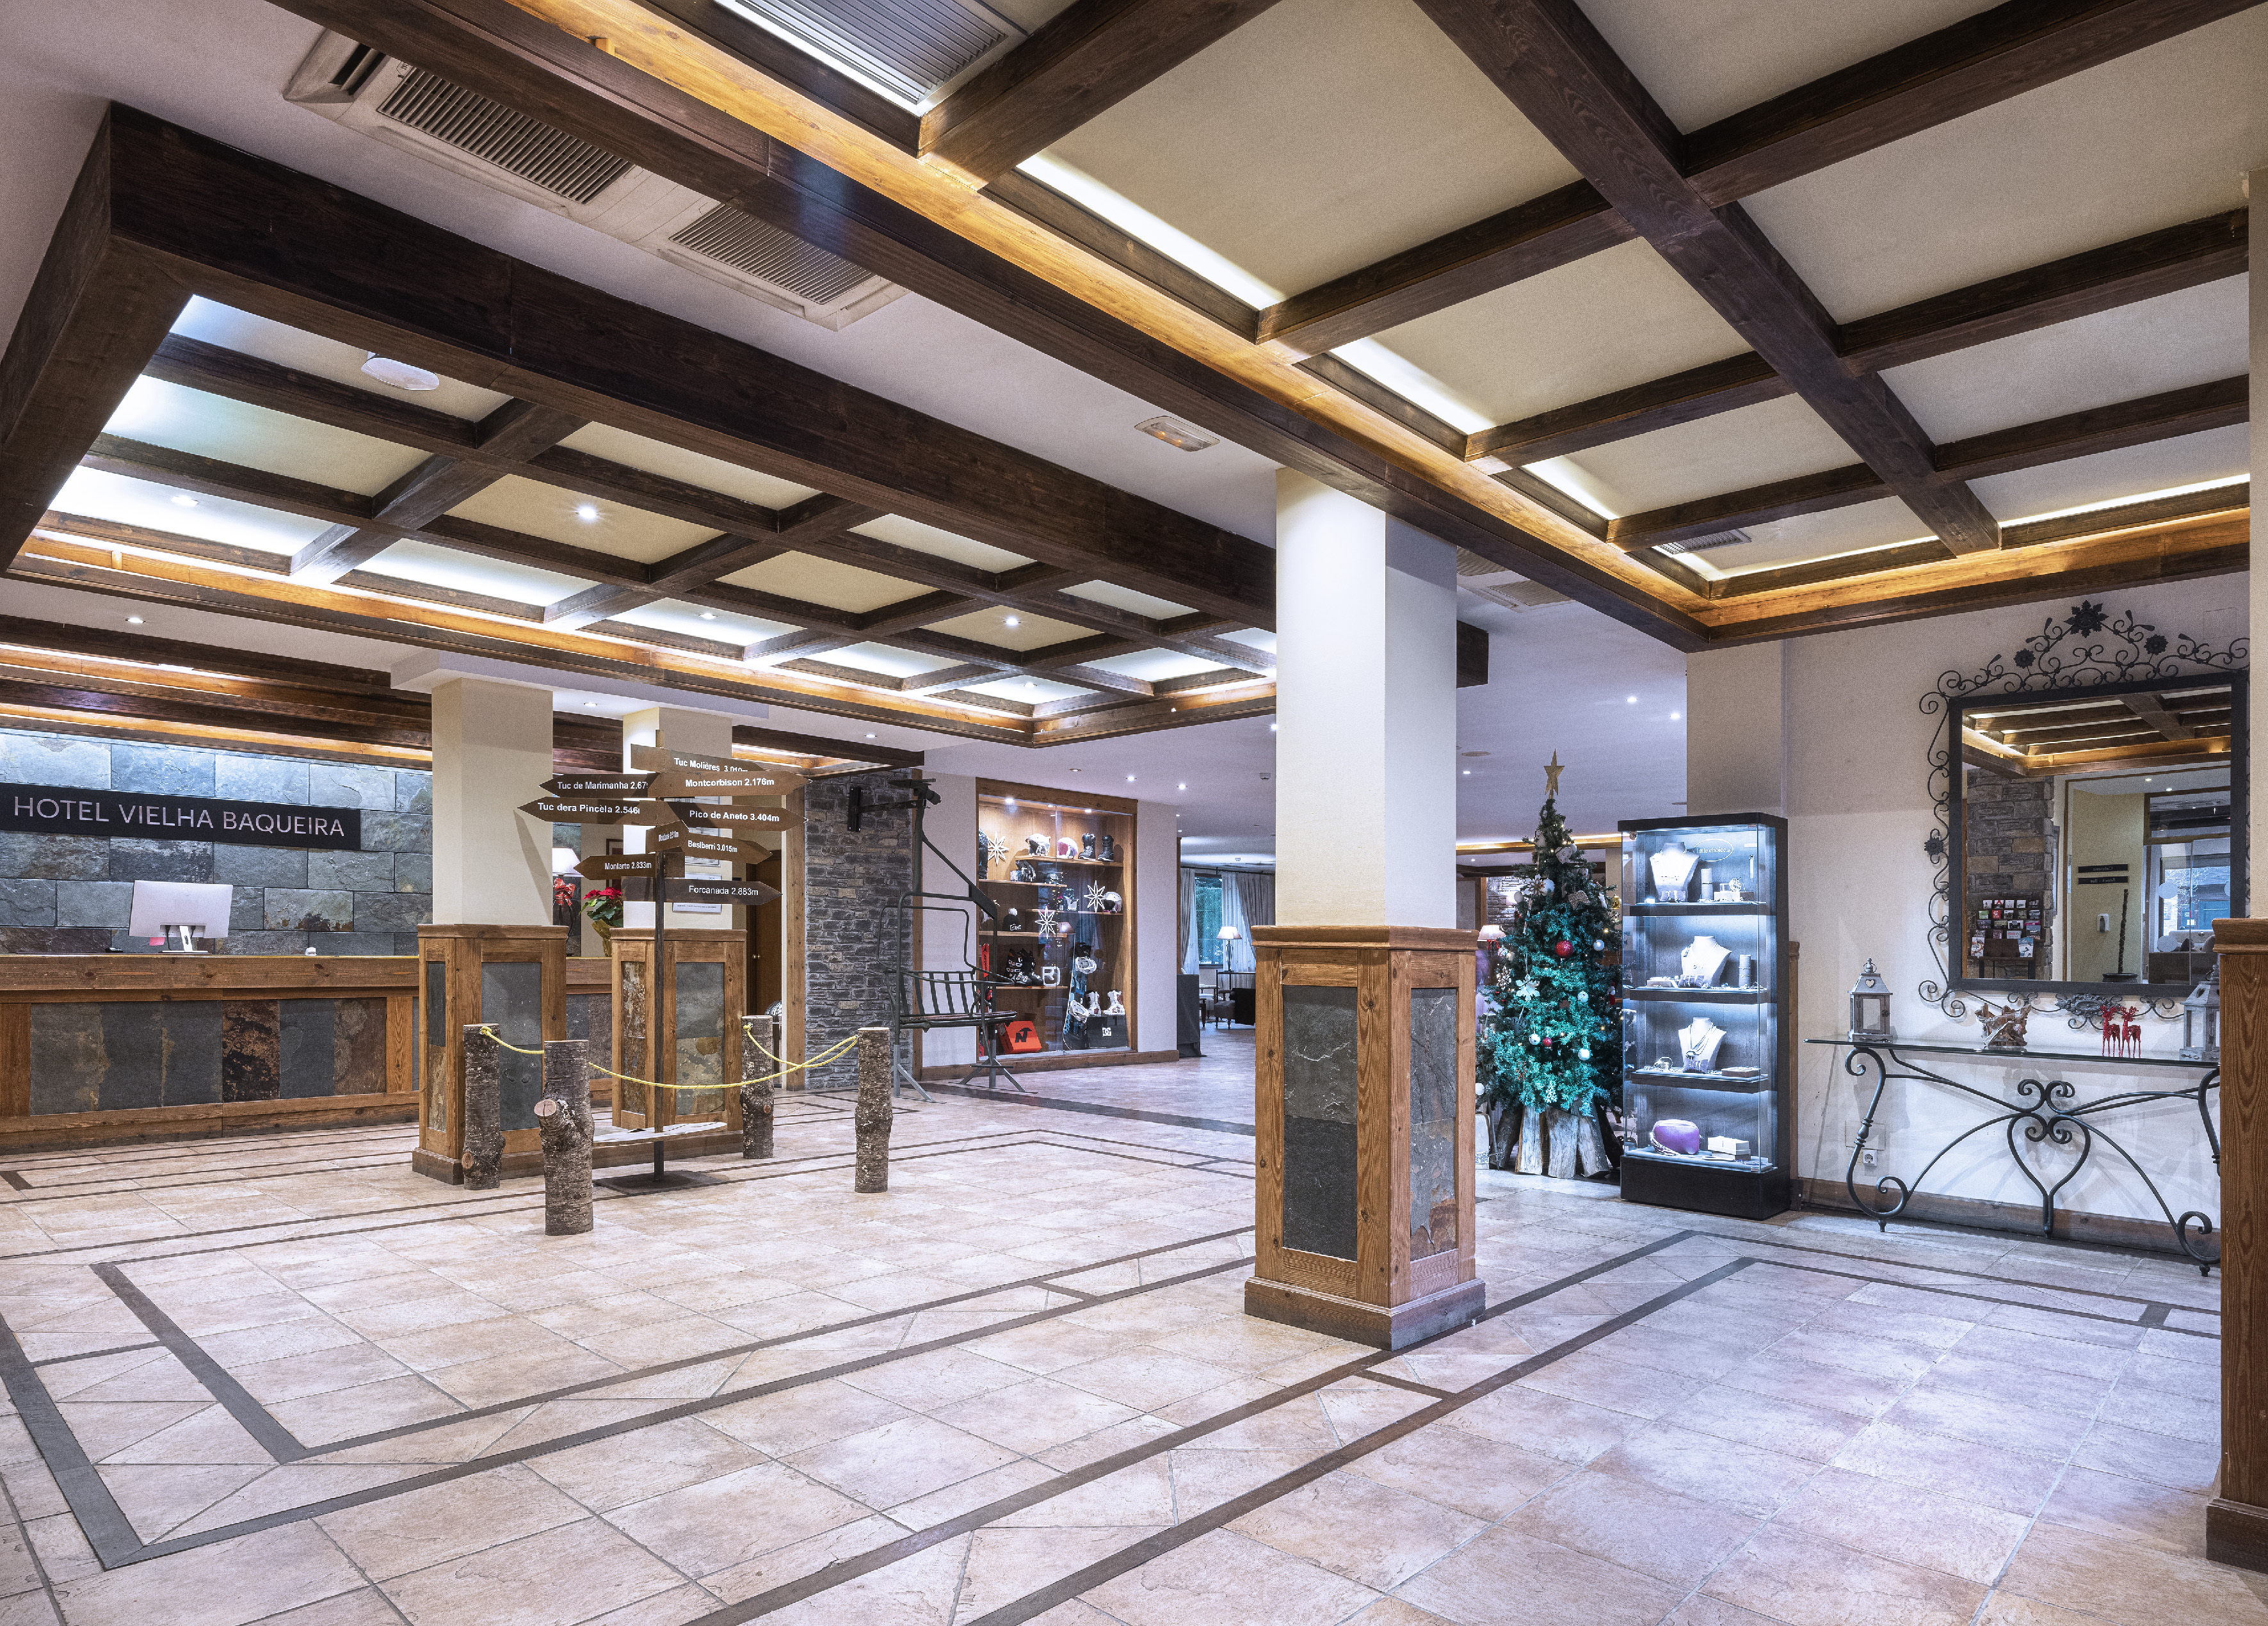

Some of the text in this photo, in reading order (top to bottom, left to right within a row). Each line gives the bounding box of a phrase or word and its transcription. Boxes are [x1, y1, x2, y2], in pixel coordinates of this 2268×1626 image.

[674, 758, 688, 767] Tuc
[689, 760, 720, 772] Molières
[585, 782, 629, 790] Marimanha
[685, 778, 775, 787] Montcorbison 2.176m
[538, 802, 554, 810] Tuc
[556, 803, 577, 812] dera
[579, 804, 613, 813] Pincèla
[14, 796, 345, 837] HOTEL VIELHA BAQUEIRA
[689, 810, 709, 818] Pico
[723, 812, 748, 821] Aneto
[750, 813, 780, 822] 3.404m
[716, 843, 738, 853] 3.015m
[631, 861, 652, 869] 2.833m
[689, 885, 759, 896] Forcanada 2.883m
